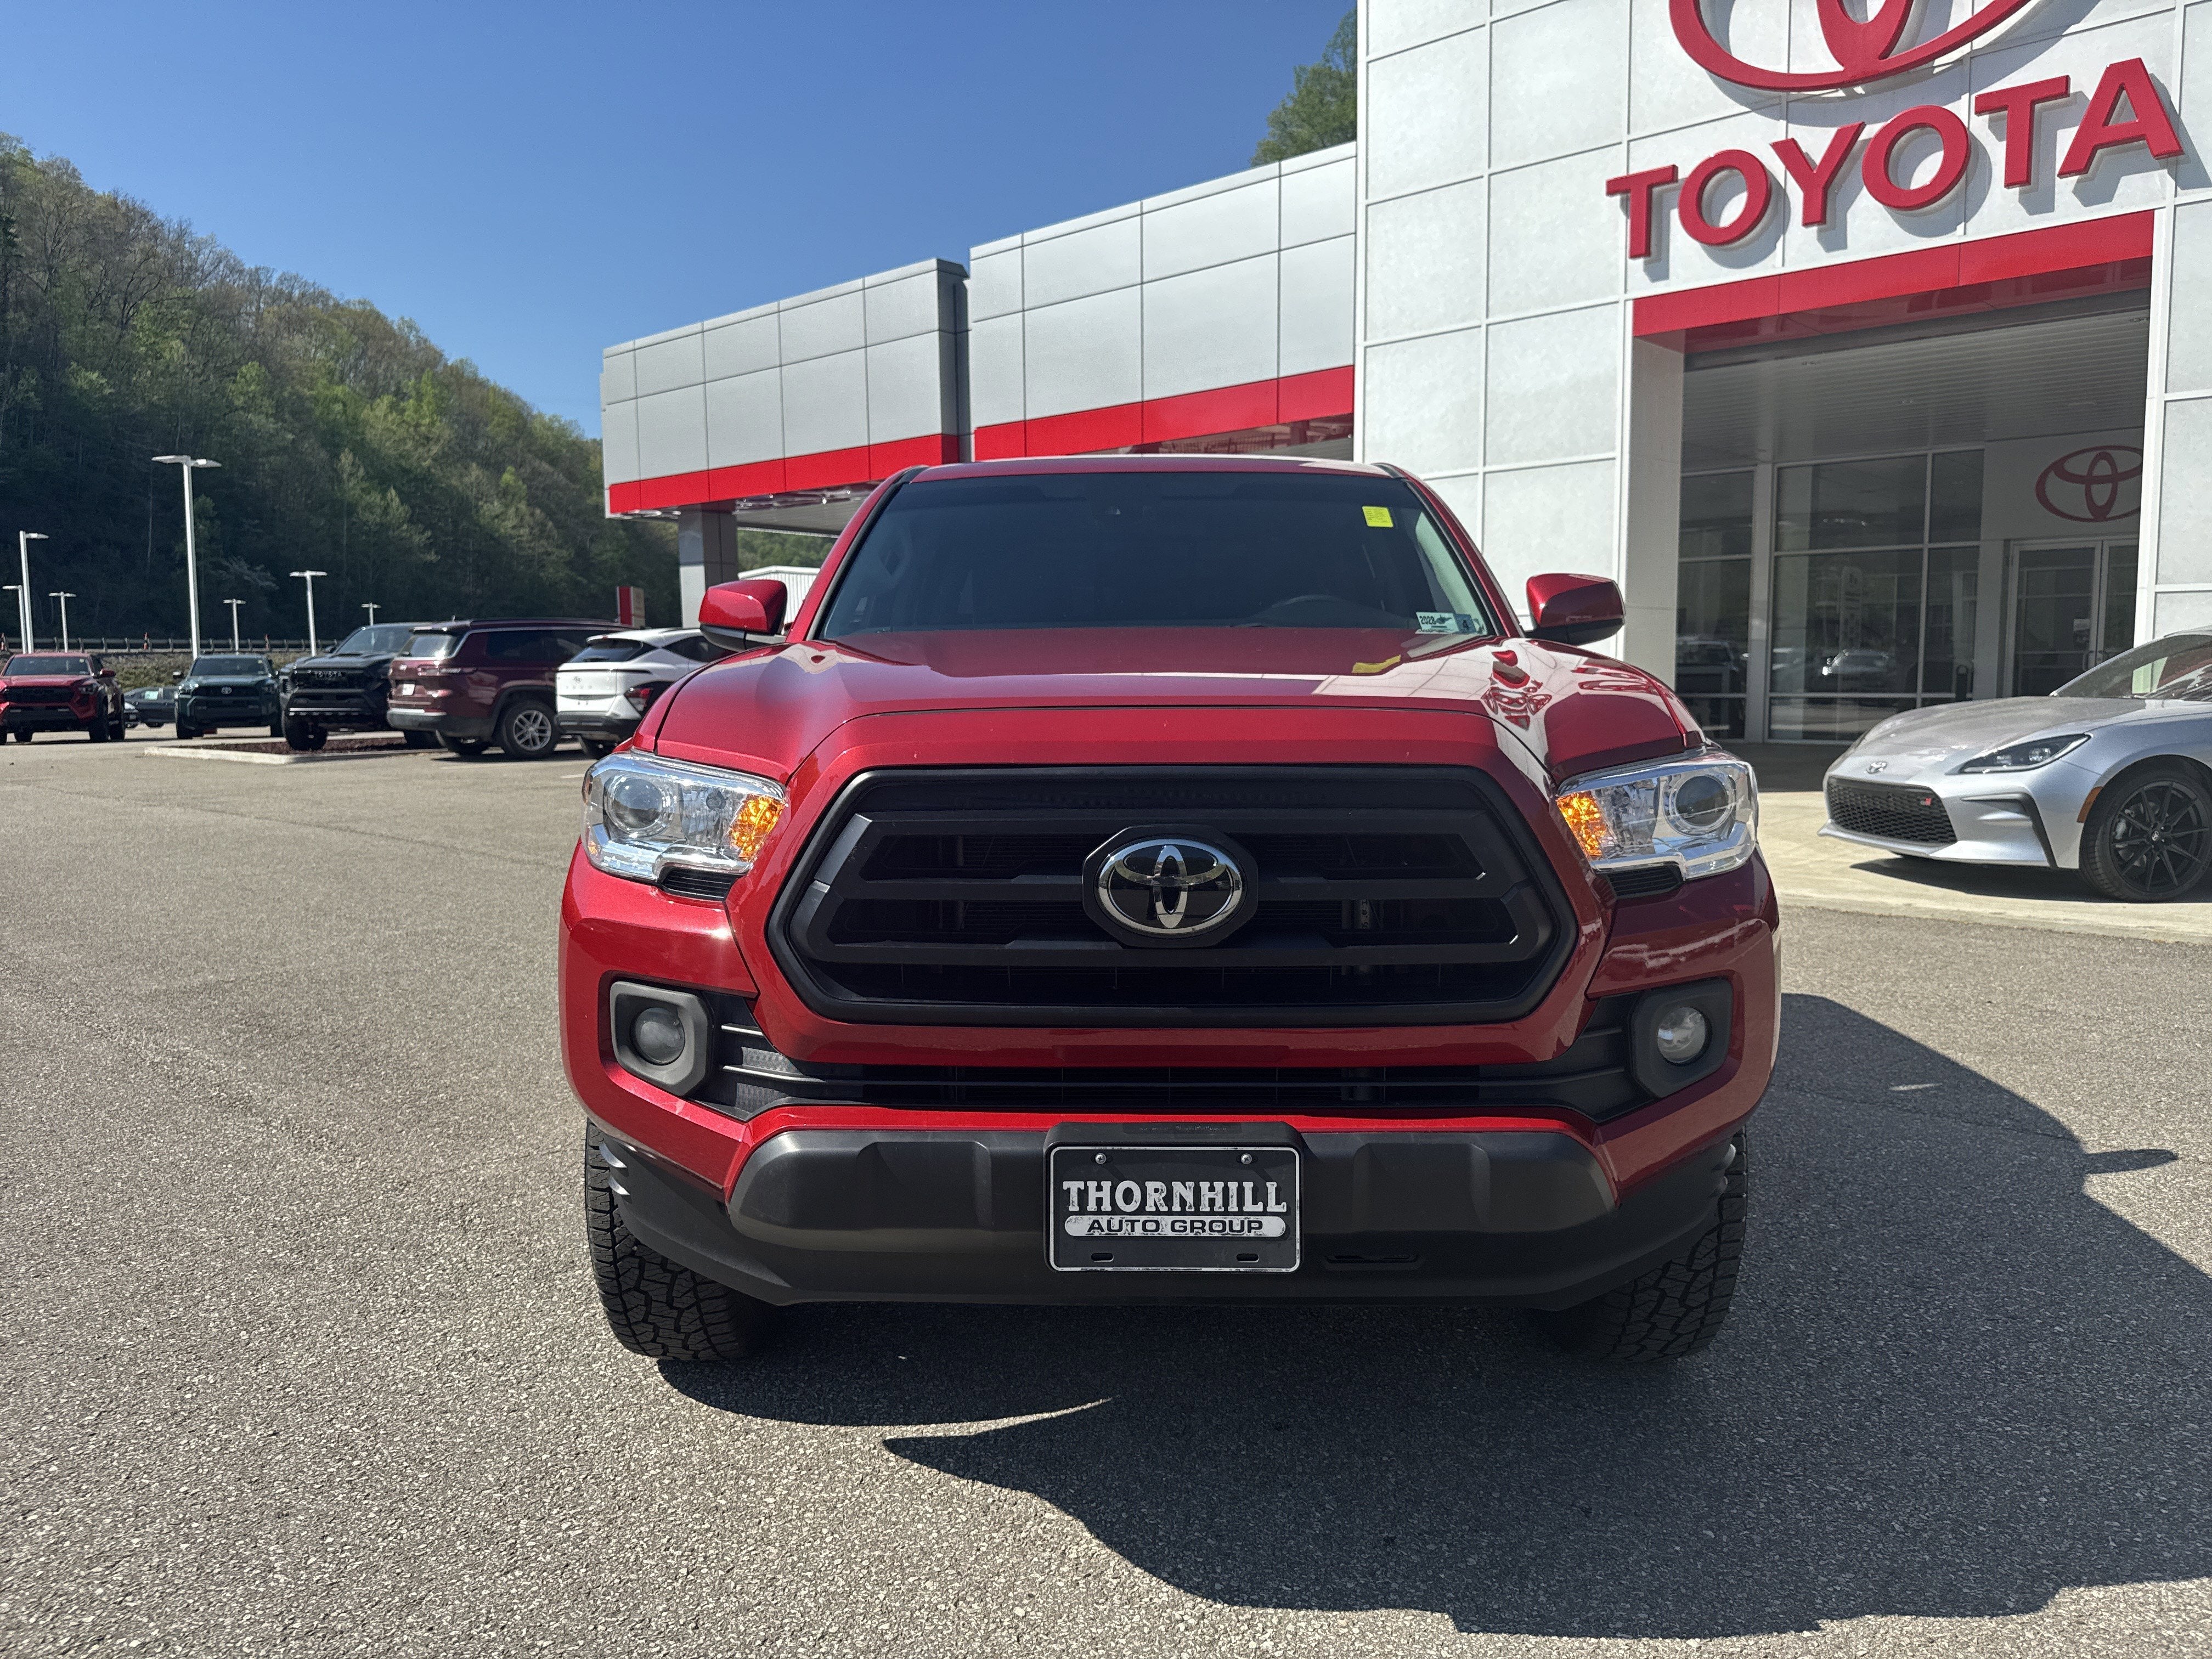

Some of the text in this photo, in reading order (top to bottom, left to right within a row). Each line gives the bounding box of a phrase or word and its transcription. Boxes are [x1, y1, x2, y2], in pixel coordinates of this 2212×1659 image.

[1606, 57, 2183, 260] TOYOTA
[1063, 1180, 1287, 1212] THORNHILL
[1087, 1219, 1263, 1233] AUTO GROUP
